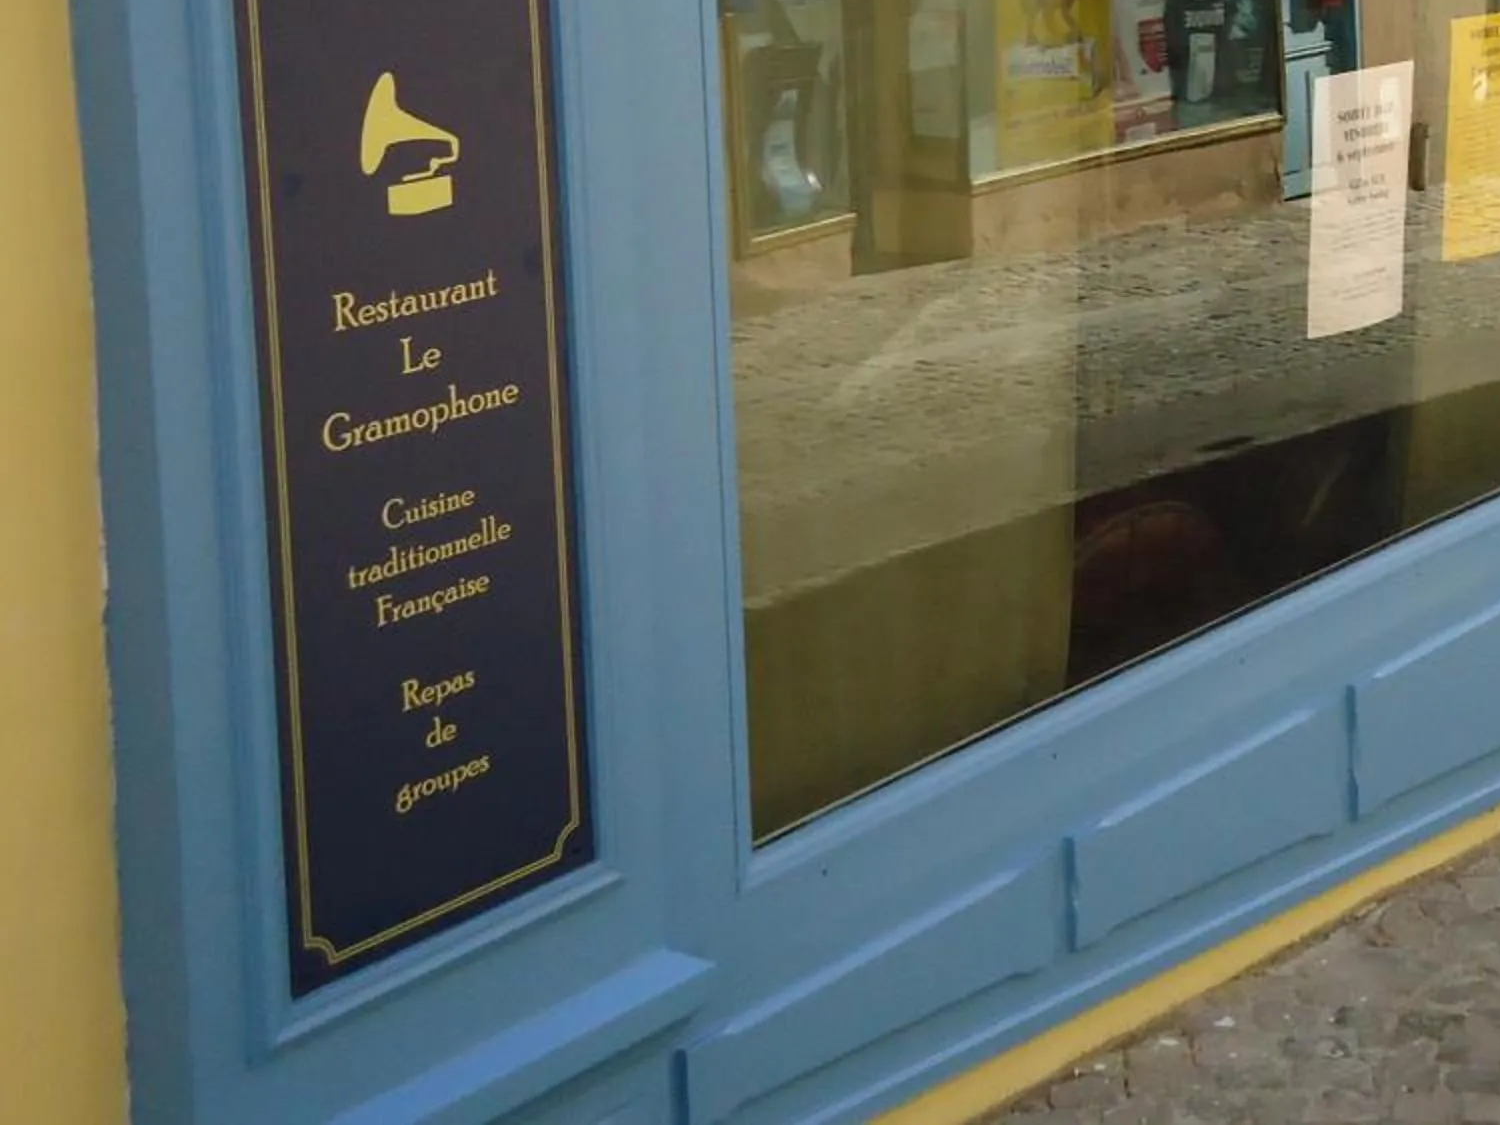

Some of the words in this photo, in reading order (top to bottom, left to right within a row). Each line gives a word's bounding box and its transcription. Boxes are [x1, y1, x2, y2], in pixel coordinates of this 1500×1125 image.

[332, 268, 500, 332] Restaurant
[399, 335, 443, 375] Le
[322, 383, 520, 452] Gramophone
[381, 489, 477, 530] Cuisine
[348, 515, 512, 590] traditionnelle
[375, 574, 492, 628] Française
[401, 670, 476, 713] Repas
[425, 716, 458, 749] de
[395, 754, 491, 814] groupes
